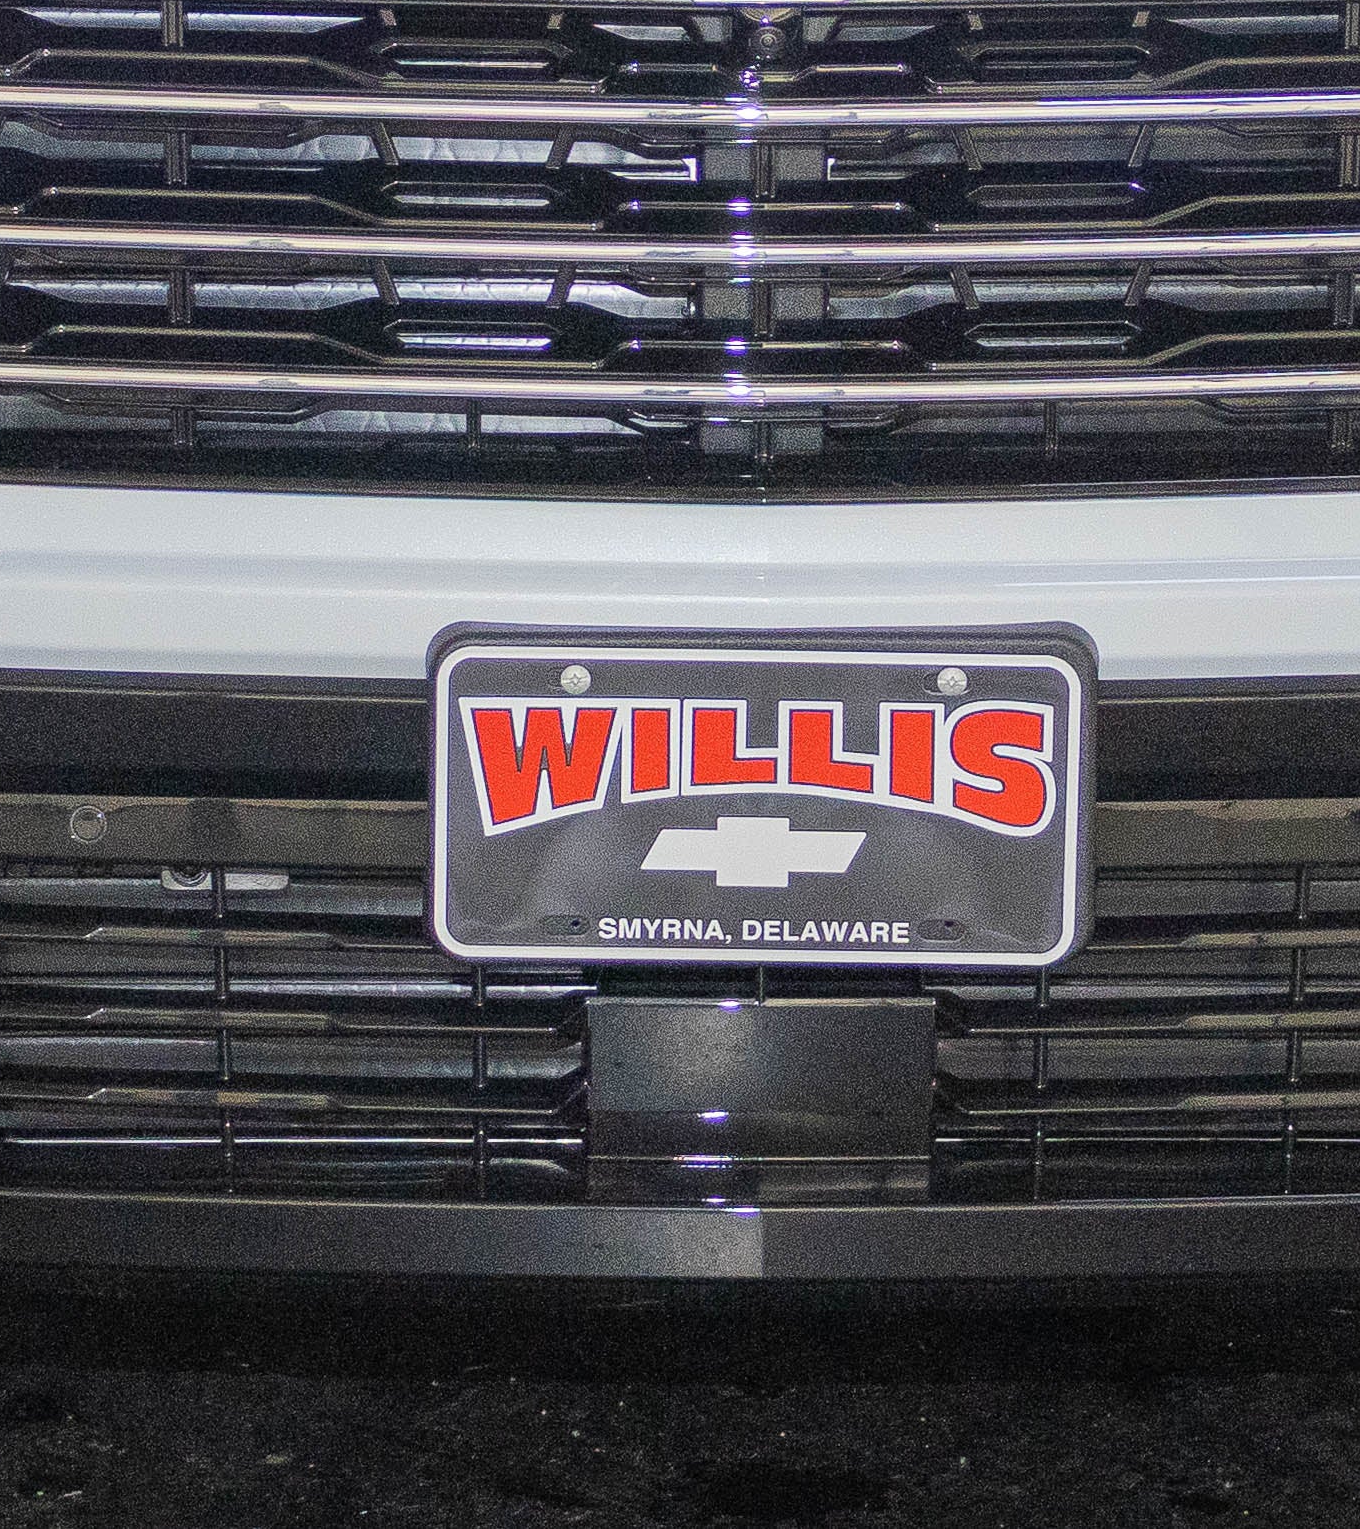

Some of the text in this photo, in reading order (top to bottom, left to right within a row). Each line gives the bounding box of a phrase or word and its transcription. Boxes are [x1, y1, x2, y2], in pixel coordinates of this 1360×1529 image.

[459, 696, 1058, 837] WILLIS
[597, 917, 911, 945] SMYRNA, DELAWARE
